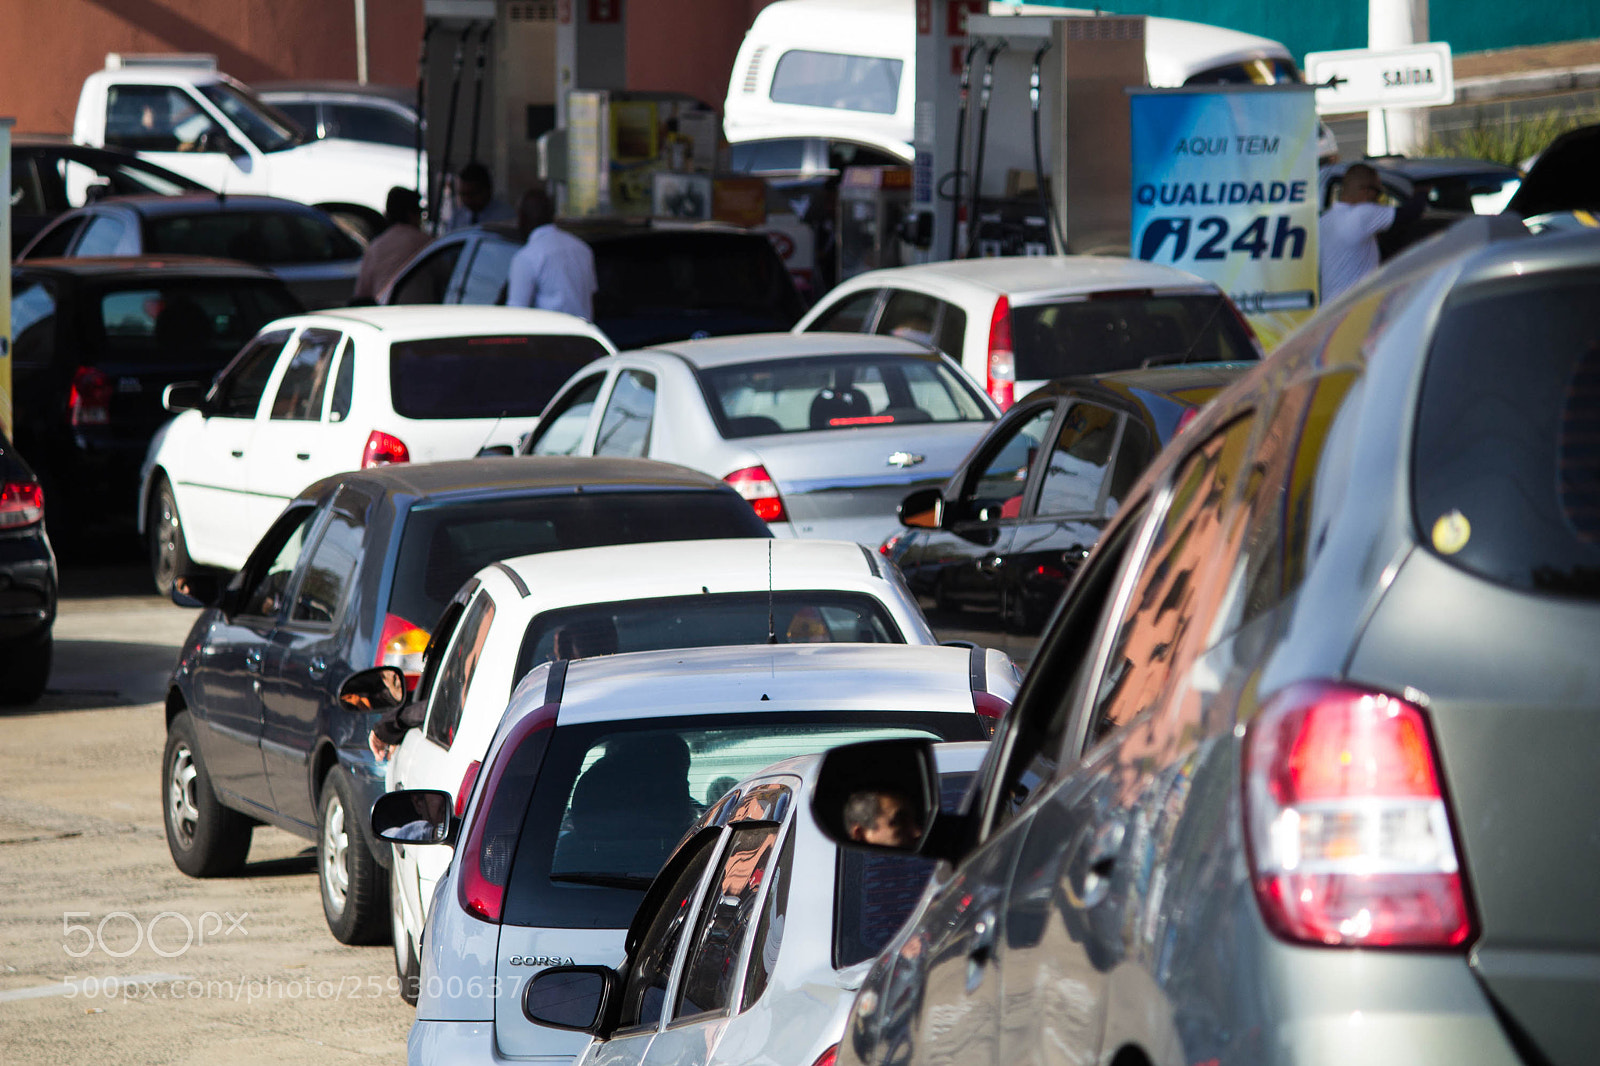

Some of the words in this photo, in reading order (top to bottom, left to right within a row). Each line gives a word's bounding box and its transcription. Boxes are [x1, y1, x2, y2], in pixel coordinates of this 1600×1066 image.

[1383, 66, 1434, 87] SAÍDA
[1174, 136, 1228, 156] AQUI
[1235, 135, 1280, 155] TEM
[1137, 180, 1307, 207] QUALIDADE
[1194, 214, 1307, 260] 24h
[509, 955, 576, 967] CORSA
